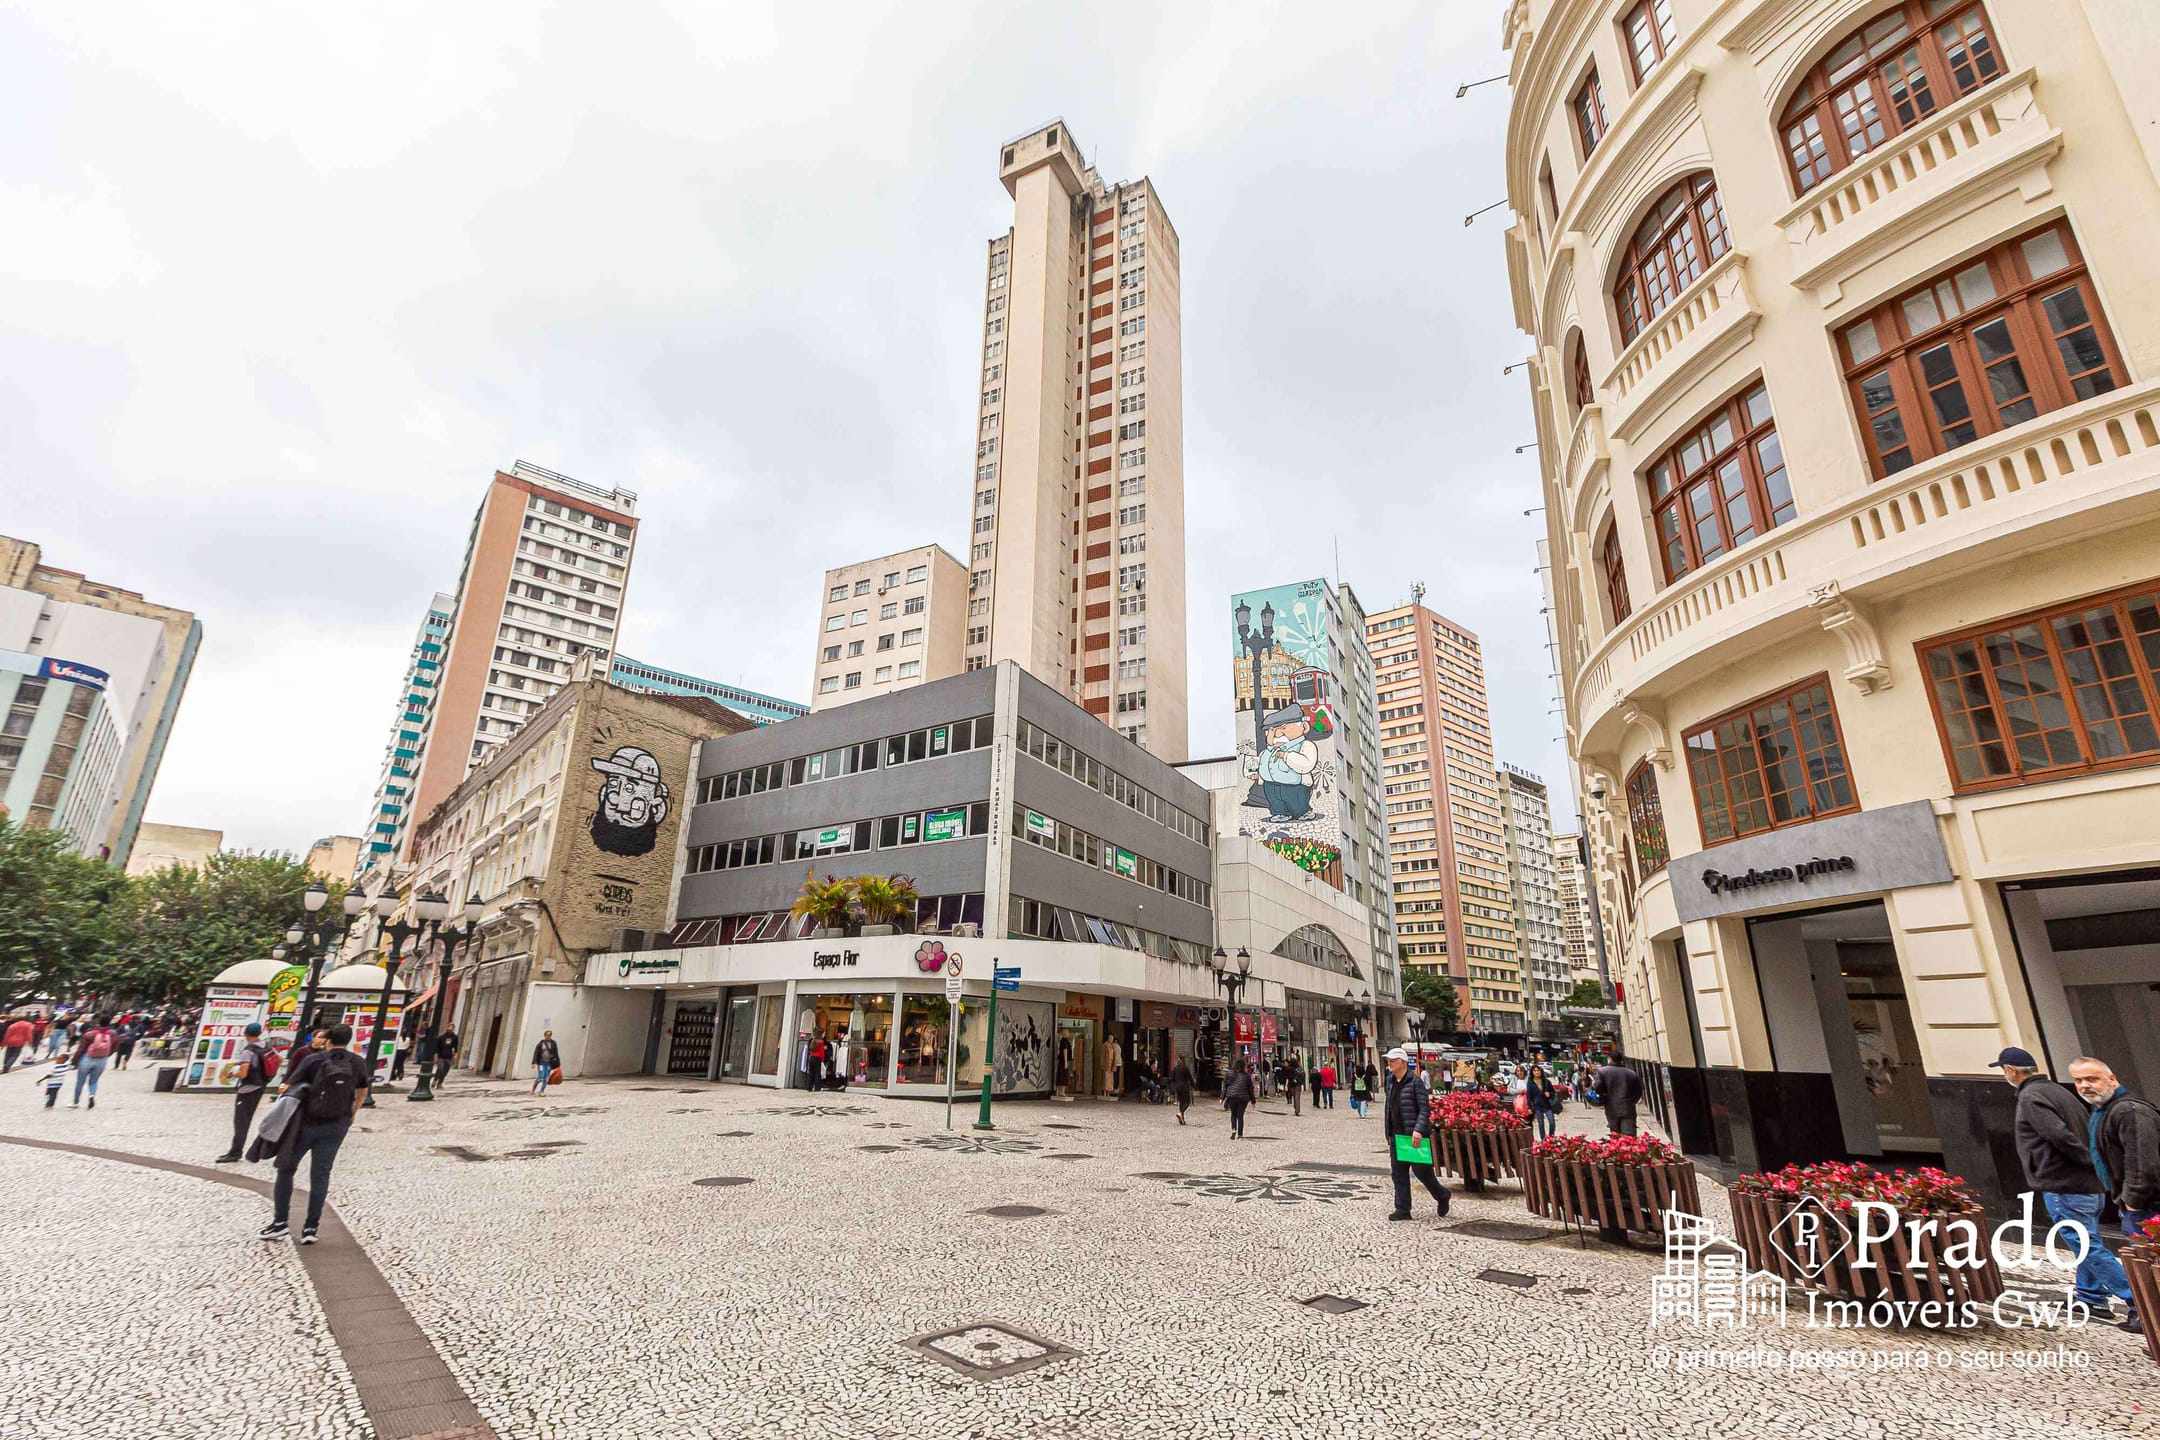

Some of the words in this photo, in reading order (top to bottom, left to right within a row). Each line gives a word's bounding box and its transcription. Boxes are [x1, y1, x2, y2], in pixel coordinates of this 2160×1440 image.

[1795, 855, 1857, 882] prime
[813, 951, 841, 970] Espaço
[843, 949, 860, 966] Flor
